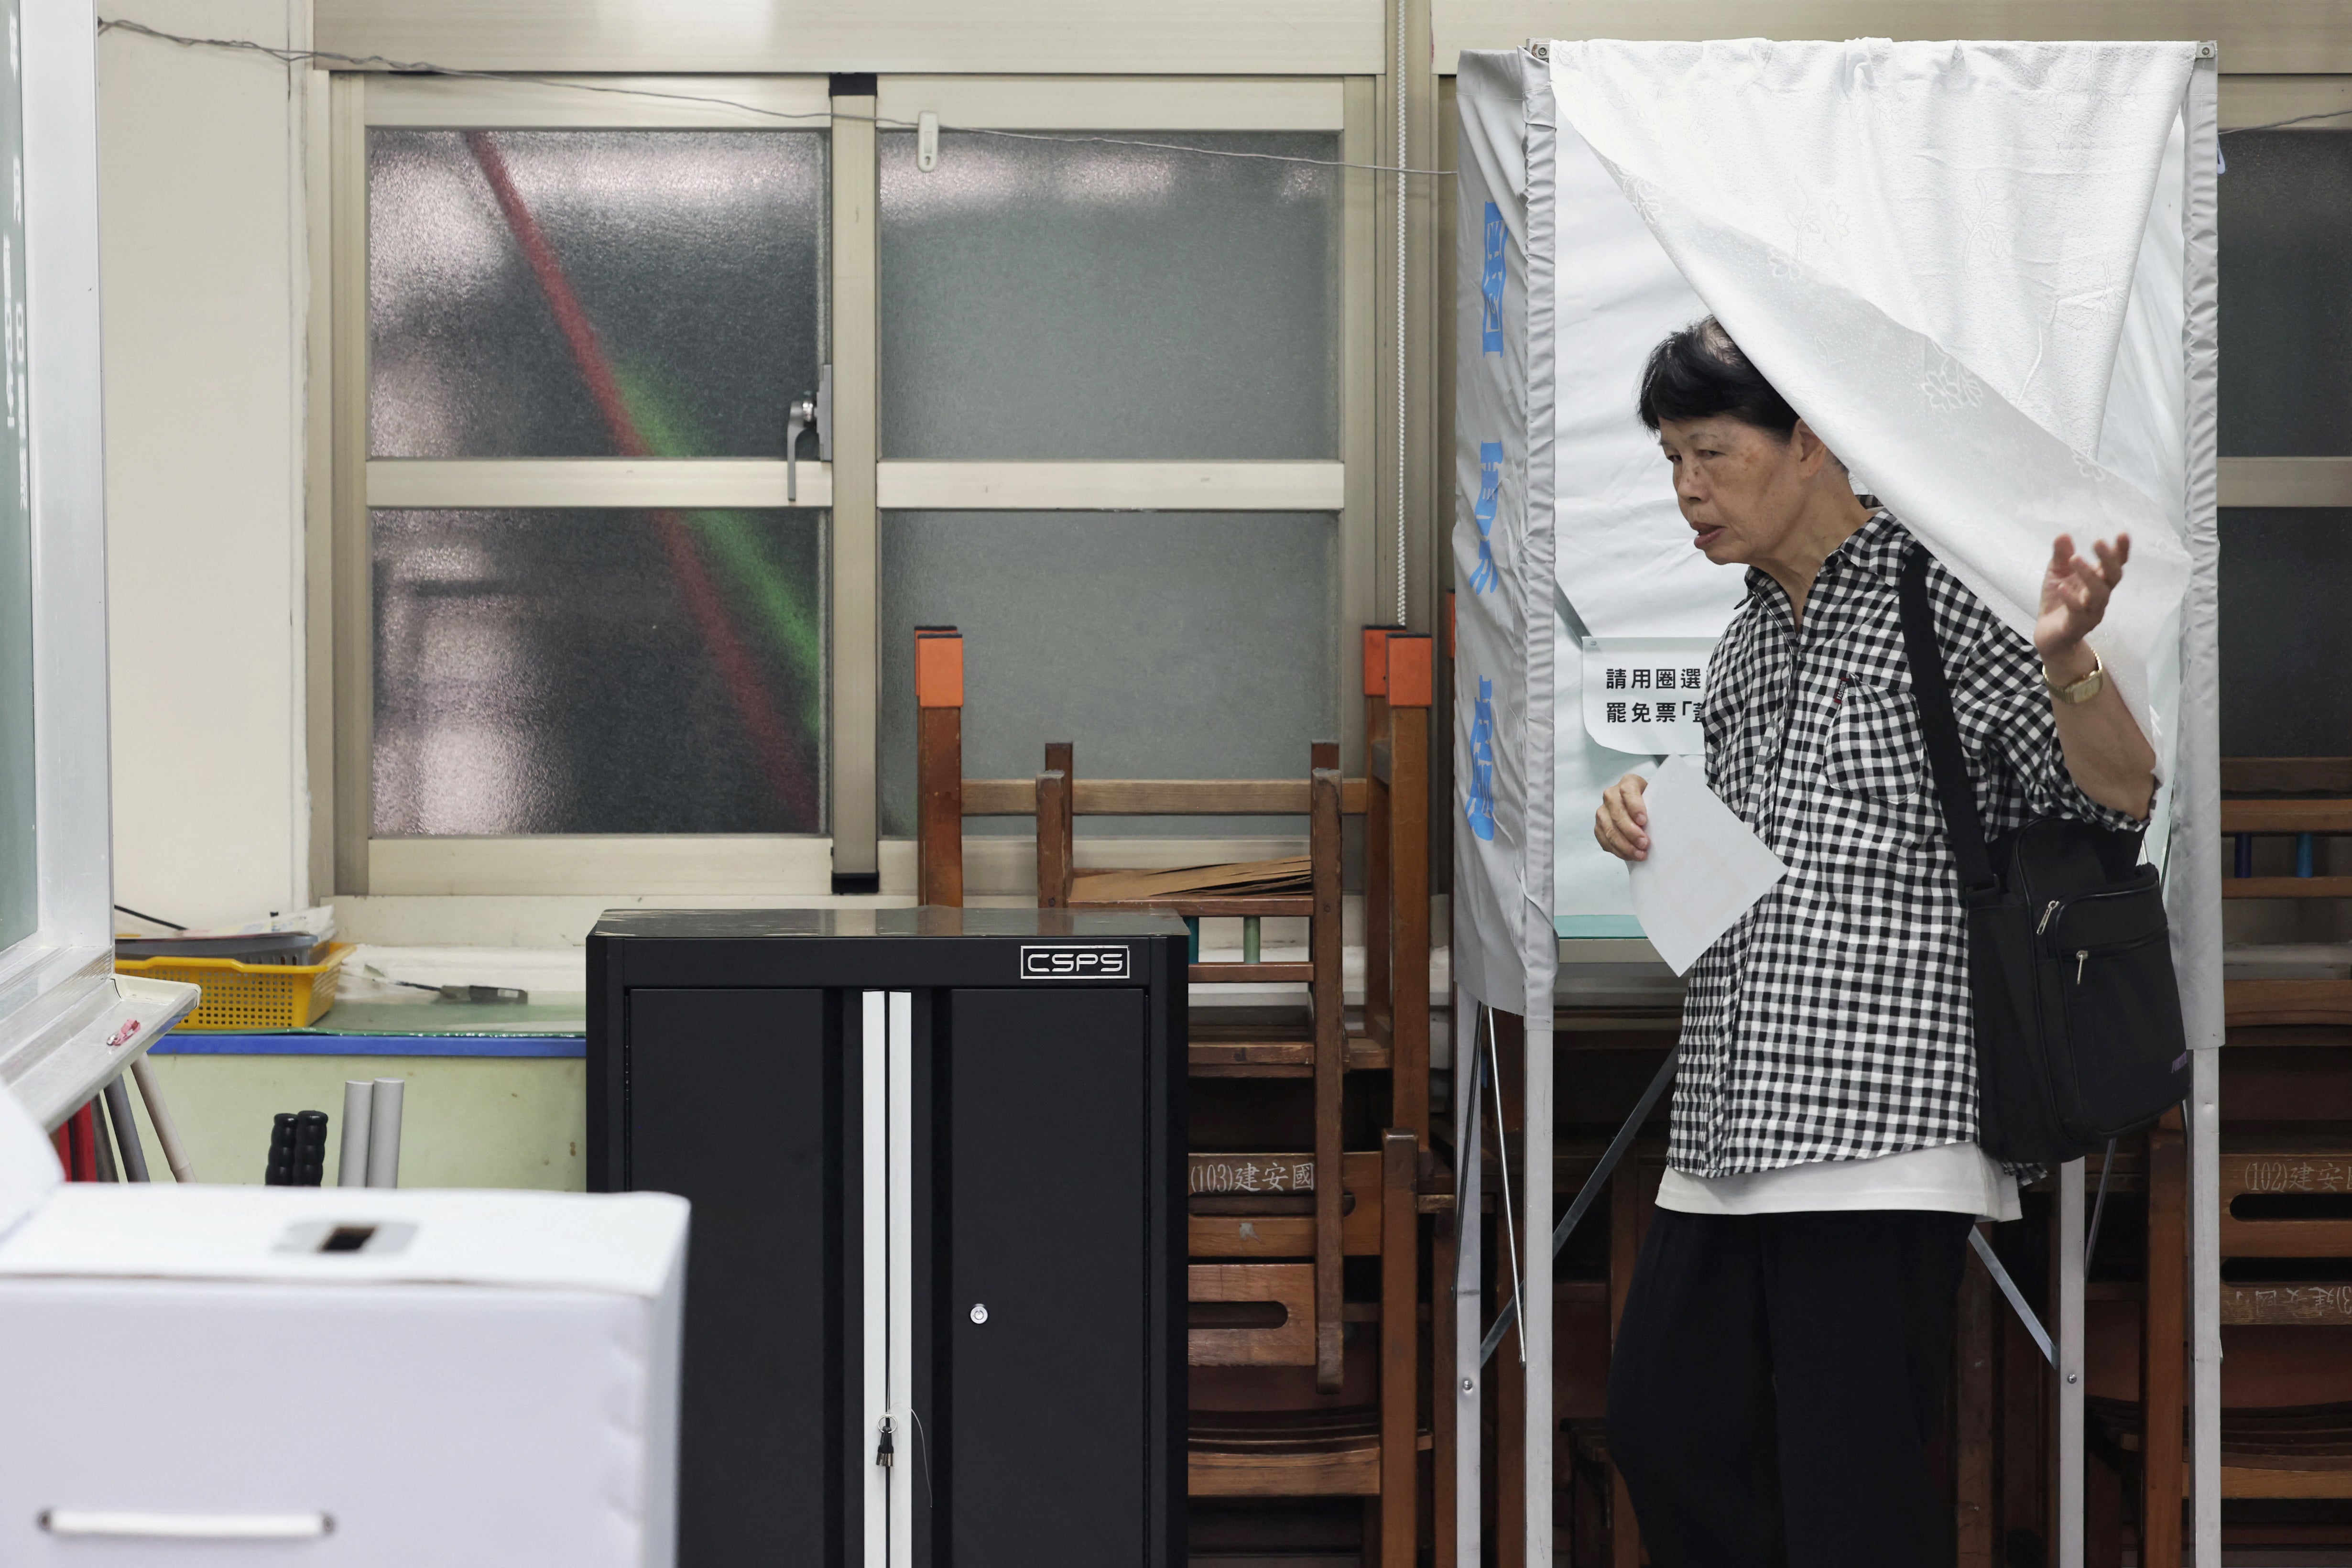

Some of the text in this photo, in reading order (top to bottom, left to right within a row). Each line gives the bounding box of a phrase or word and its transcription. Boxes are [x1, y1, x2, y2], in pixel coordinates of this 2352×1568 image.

[1606, 668, 1701, 689] 請用圈選
[1836, 681, 1847, 700] FASHION
[1027, 953, 1123, 972] CSPS
[1190, 1162, 1315, 1193] (103)建安國
[2244, 1162, 2352, 1193] (102)建安
